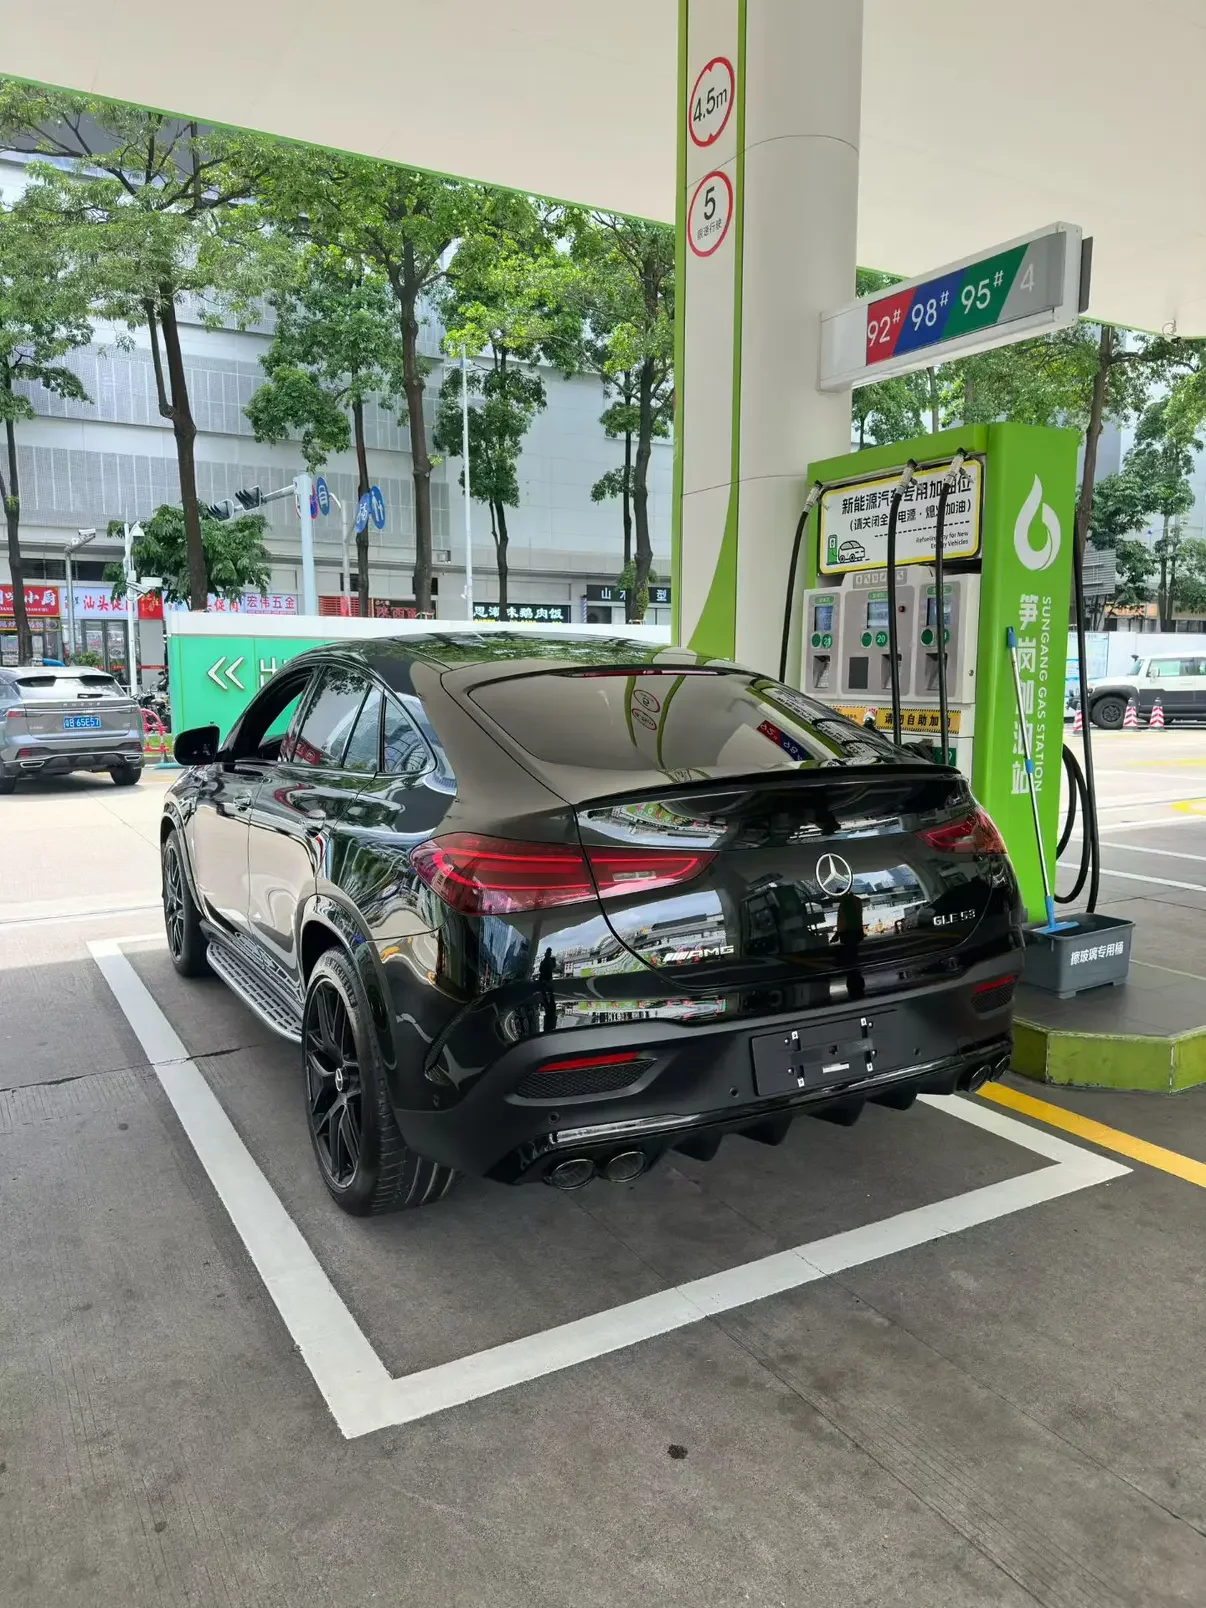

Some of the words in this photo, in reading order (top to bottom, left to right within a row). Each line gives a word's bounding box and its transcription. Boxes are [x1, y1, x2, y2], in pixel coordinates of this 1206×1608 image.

[693, 87, 728, 123] 4.5m
[703, 186, 716, 221] 5
[1020, 263, 1034, 293] 4
[246, 595, 295, 610] 宏伟五金
[877, 634, 886, 643] 20
[1039, 596, 1052, 682] SUNGANG
[1037, 687, 1047, 719] GAS
[1034, 724, 1046, 792] STATION
[932, 912, 958, 926] GLE
[960, 908, 976, 921] 53
[328, 960, 355, 1004] MICHELIN
